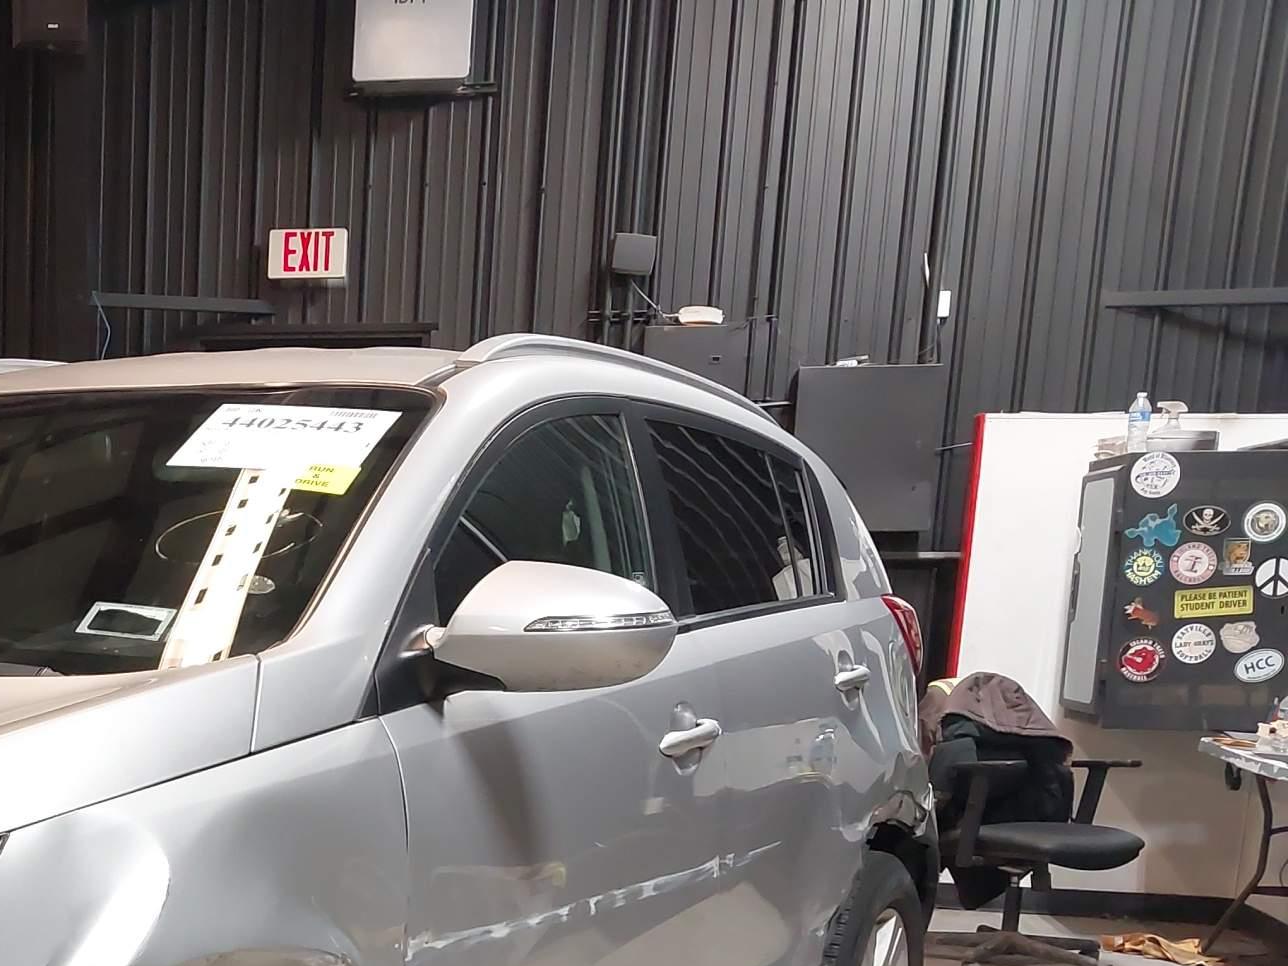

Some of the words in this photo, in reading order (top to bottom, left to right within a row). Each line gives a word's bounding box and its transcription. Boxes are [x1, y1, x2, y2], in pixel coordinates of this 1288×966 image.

[283, 231, 335, 272] EXIT
[221, 416, 364, 434] 44025443
[309, 465, 335, 474] RUN
[294, 478, 329, 488] DRIVE
[1124, 548, 1152, 567] THANK
[1151, 549, 1165, 568] YOU
[1124, 568, 1163, 586] HASHEM
[1180, 593, 1206, 602] PLEASE
[1207, 592, 1217, 600] BE
[1218, 589, 1248, 599] PATIENT
[1180, 601, 1215, 612] STUDENT
[1218, 599, 1248, 609] DRIVER
[1244, 655, 1276, 674] HCC
